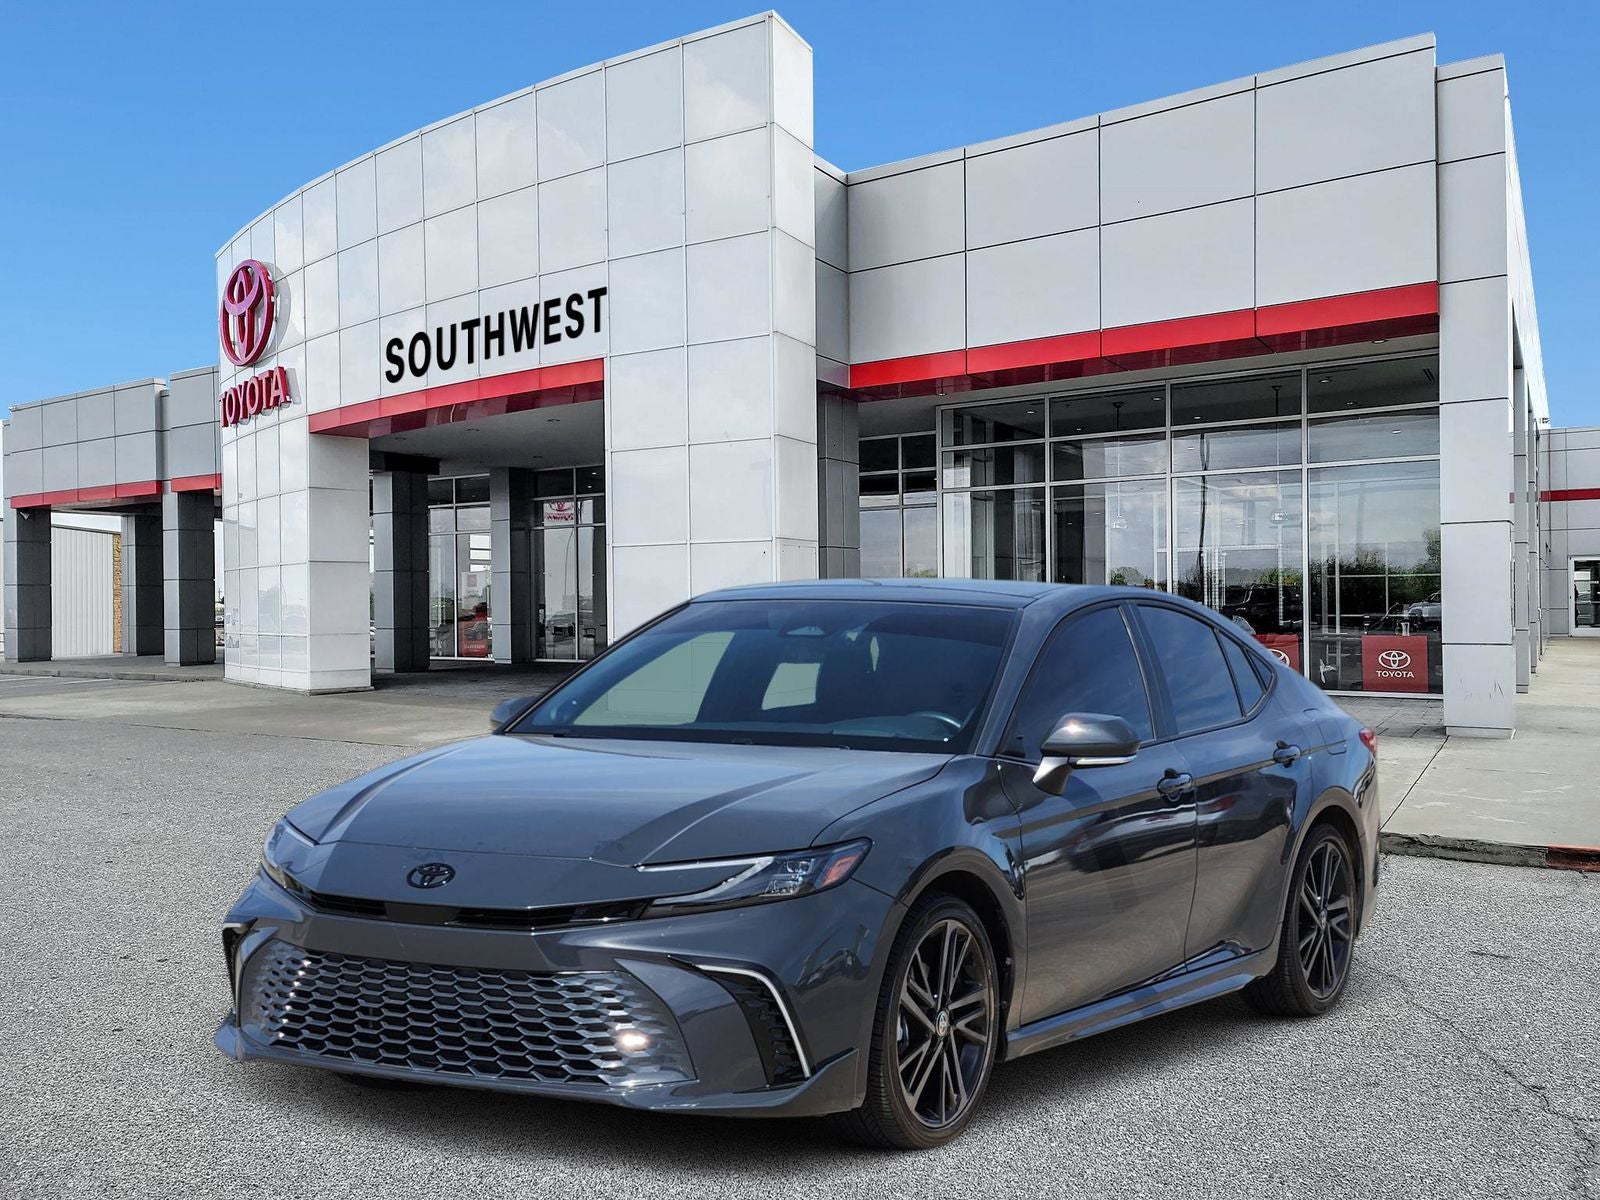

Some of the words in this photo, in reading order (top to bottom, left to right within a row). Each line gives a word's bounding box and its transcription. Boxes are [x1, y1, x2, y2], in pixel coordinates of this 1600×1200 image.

[385, 286, 608, 384] SOUTHWEST
[219, 366, 289, 428] TOYOTA
[1375, 670, 1415, 678] TOYOTA
